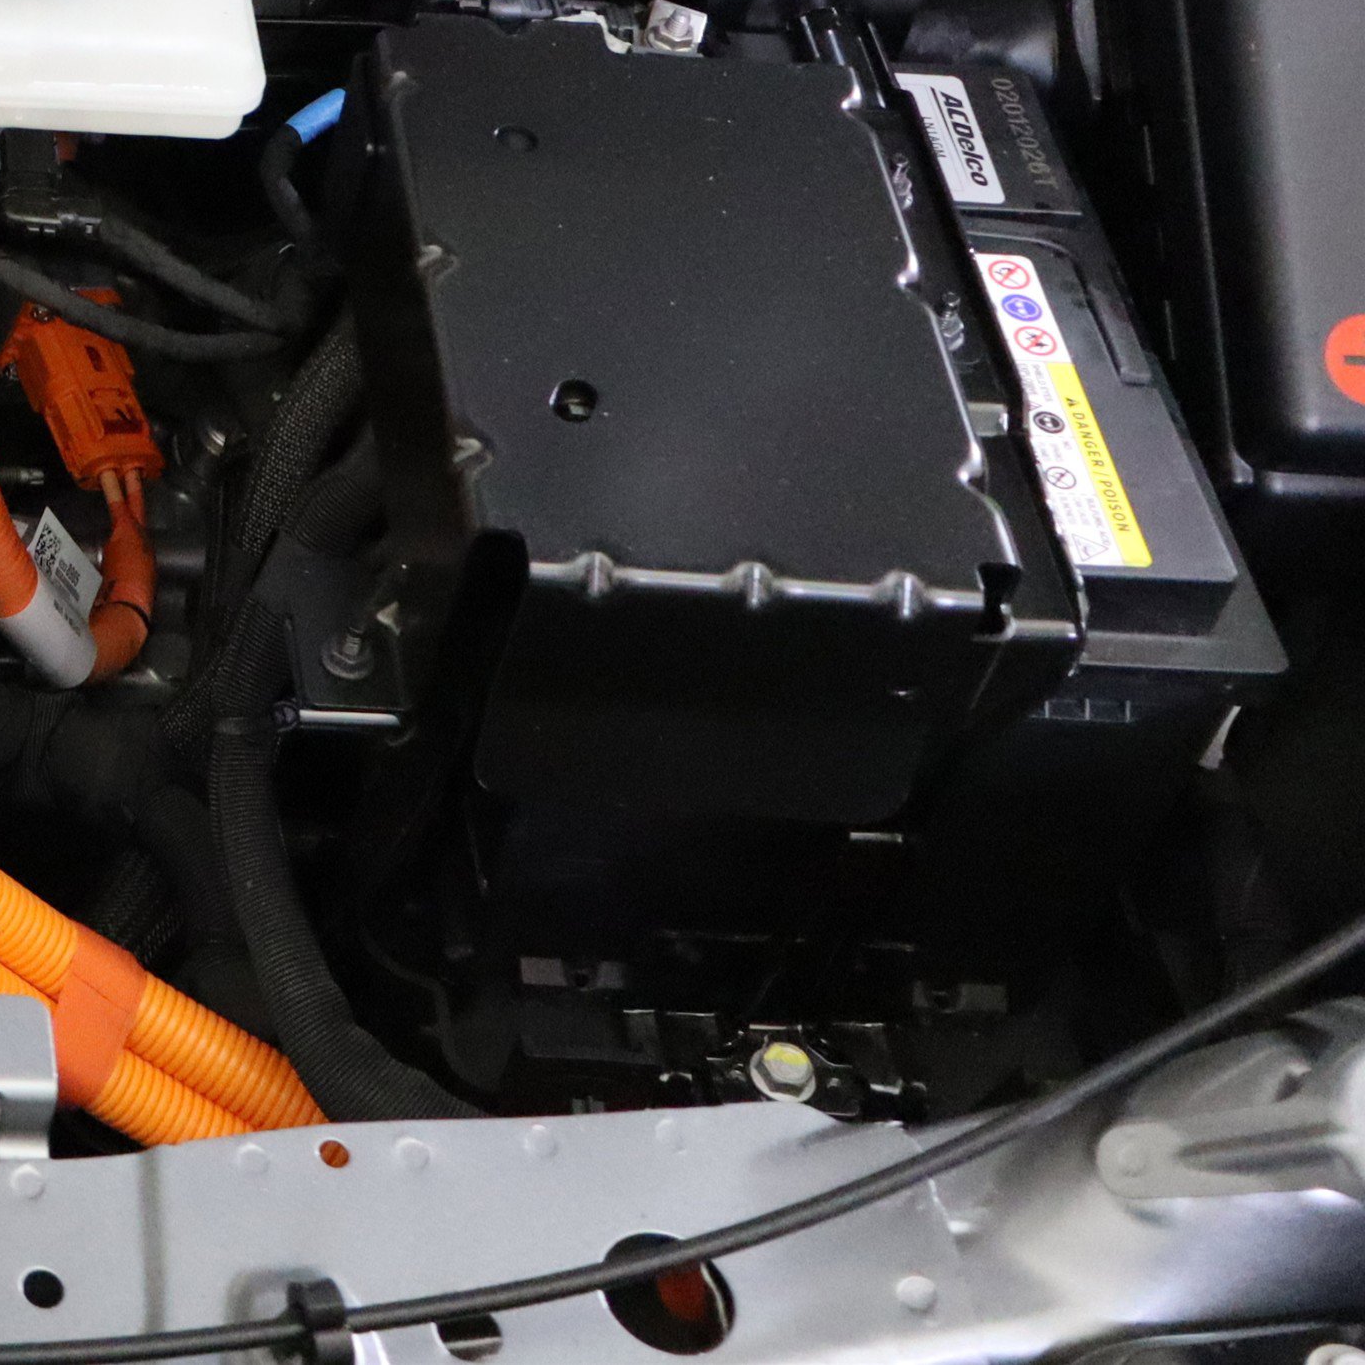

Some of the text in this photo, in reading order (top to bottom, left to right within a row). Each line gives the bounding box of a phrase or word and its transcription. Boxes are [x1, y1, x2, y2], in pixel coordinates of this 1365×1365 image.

[939, 91, 988, 187] ACDelco
[1072, 412, 1105, 468] DANGER
[1098, 480, 1130, 532] POISON
